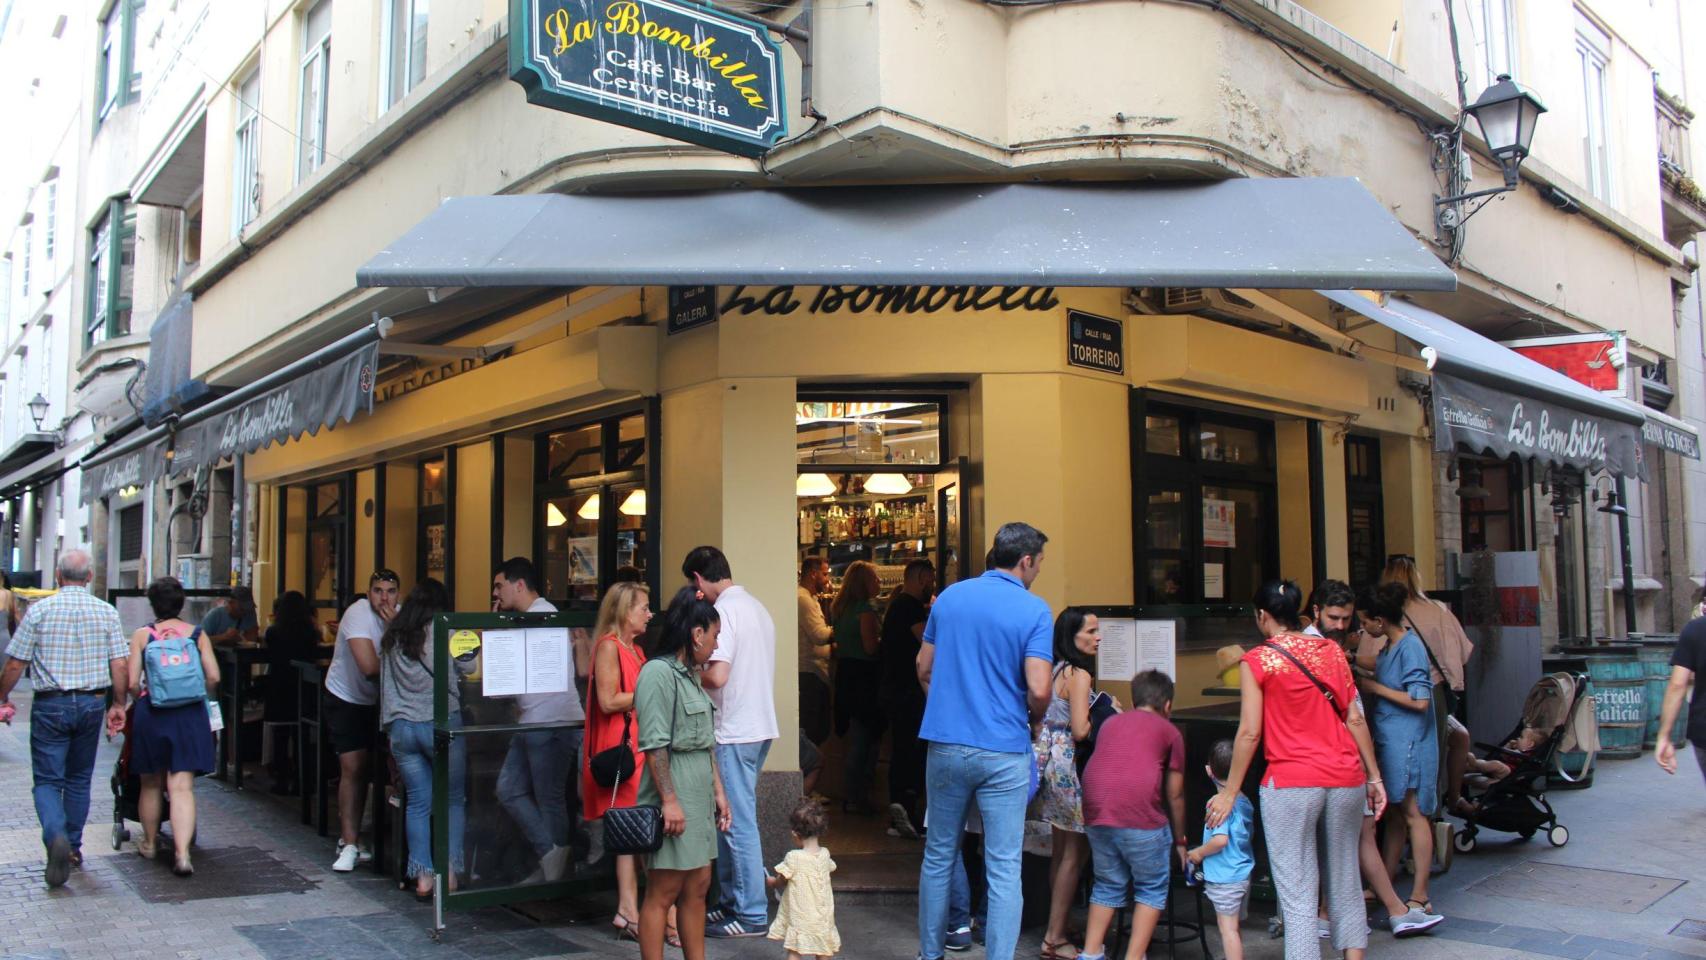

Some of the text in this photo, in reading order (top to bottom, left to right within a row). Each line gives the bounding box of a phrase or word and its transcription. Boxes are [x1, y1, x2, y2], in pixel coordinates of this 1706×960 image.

[545, 1, 768, 110] La Bombilla
[606, 50, 716, 93] Café Bar
[593, 68, 730, 117] Cervecería
[675, 304, 708, 326] GALERA
[1072, 343, 1120, 369] TORREIRO
[219, 413, 238, 450] La
[1507, 402, 1607, 461] La Bombilla
[1594, 689, 1641, 704] strella
